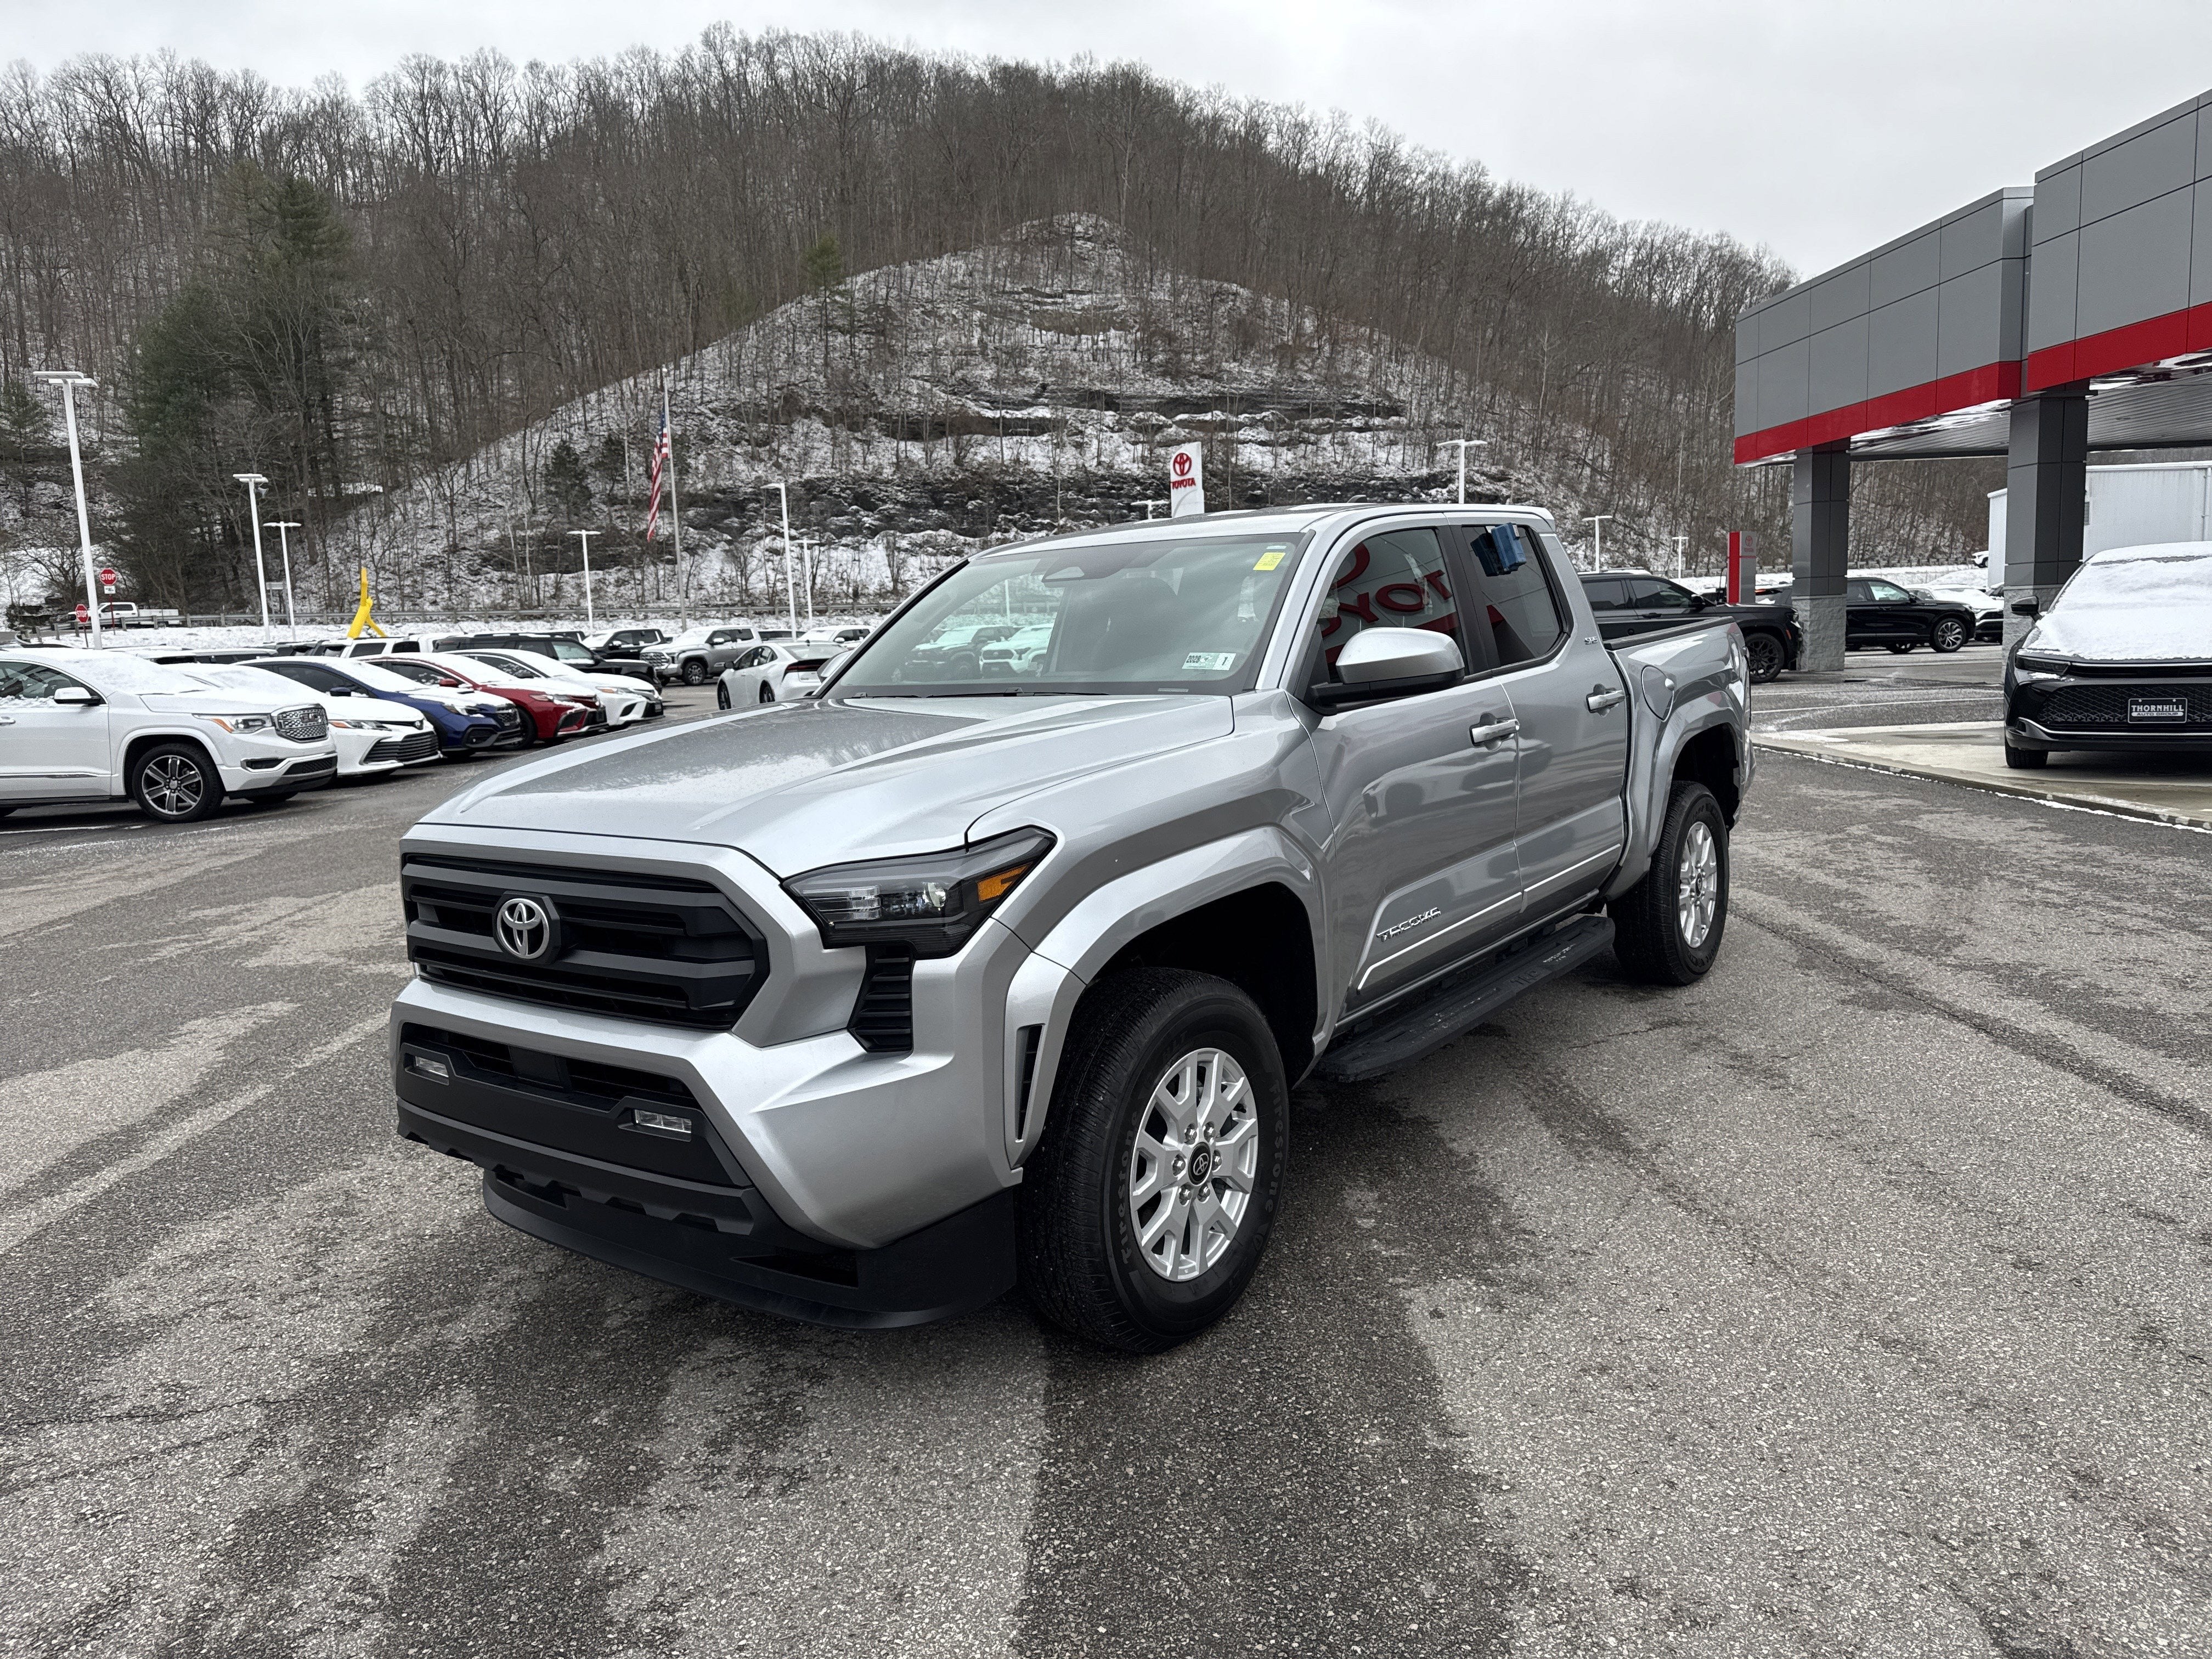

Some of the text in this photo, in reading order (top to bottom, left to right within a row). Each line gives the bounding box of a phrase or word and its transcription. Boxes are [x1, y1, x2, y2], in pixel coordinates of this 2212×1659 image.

[1170, 478, 1196, 489] TOYOTA
[1221, 657, 1228, 666] 1
[1376, 907, 1441, 942] TACOMA
[1265, 1079, 1283, 1212] Firestone
[1118, 1111, 1138, 1264] Firestone
